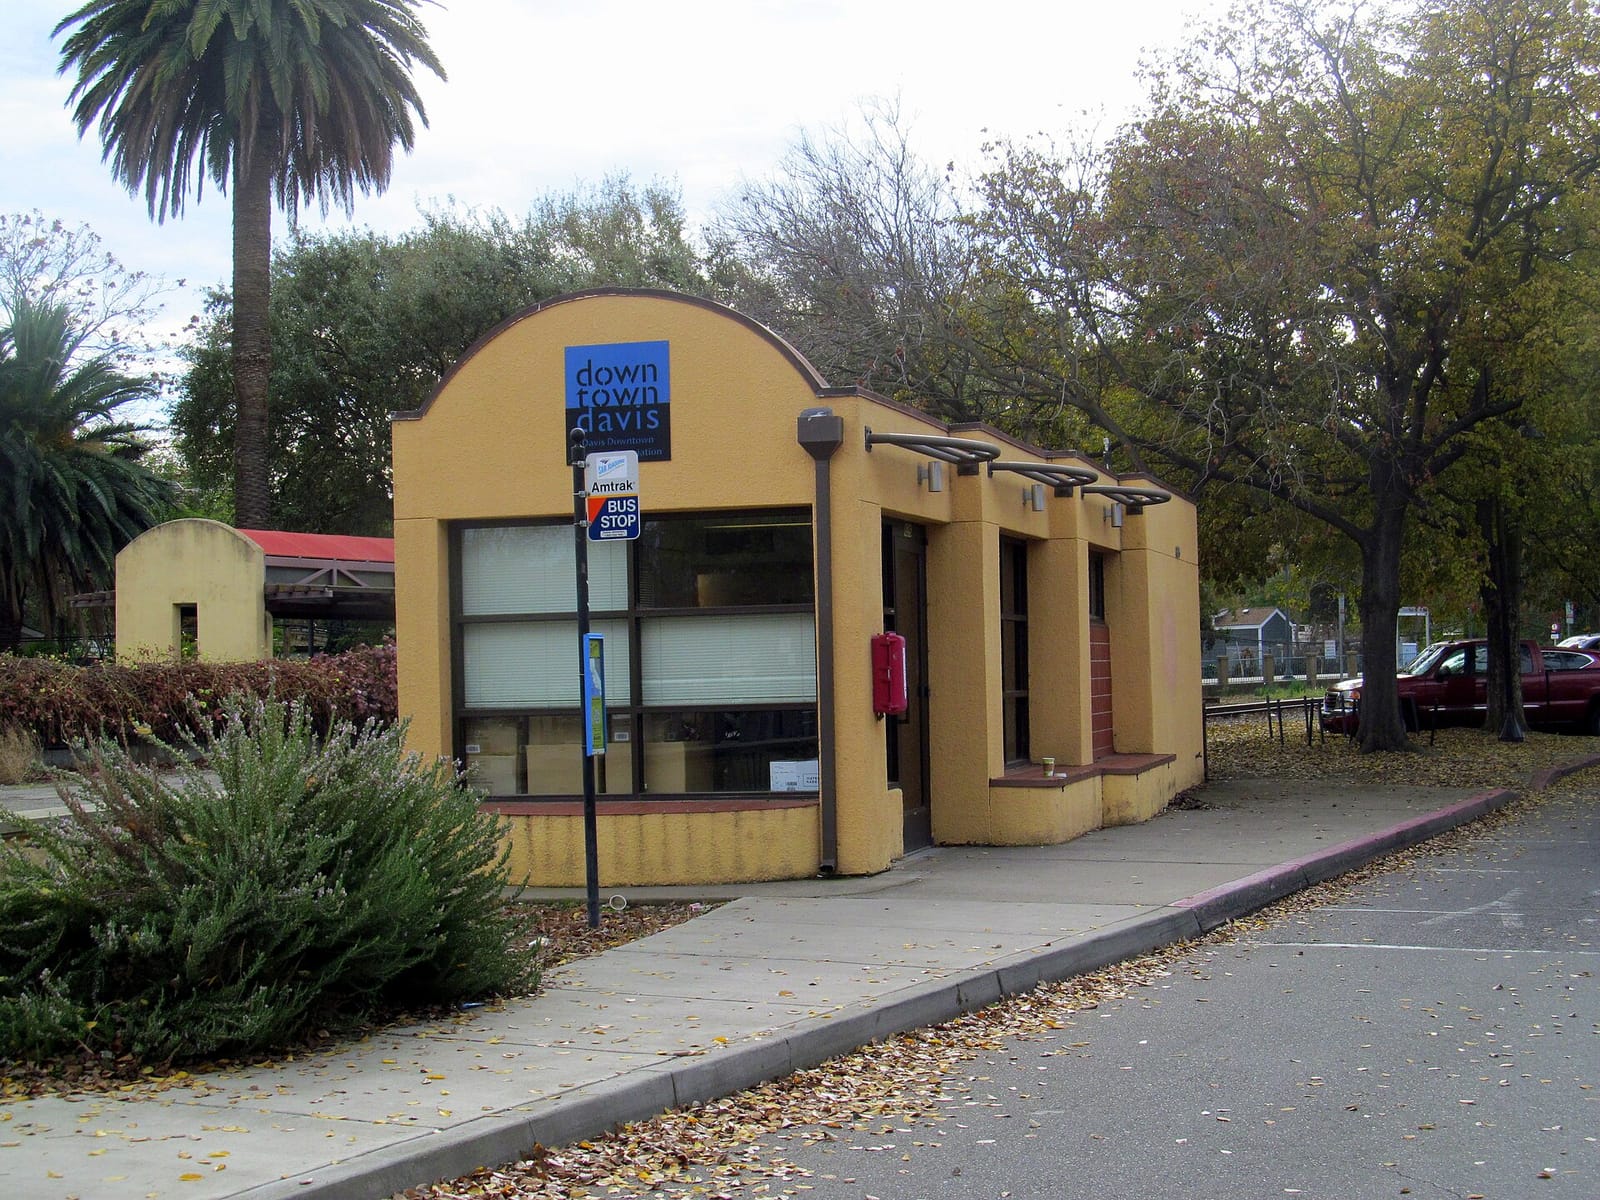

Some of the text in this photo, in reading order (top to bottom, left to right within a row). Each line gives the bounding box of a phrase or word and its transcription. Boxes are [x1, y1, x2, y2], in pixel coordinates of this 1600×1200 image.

[576, 359, 658, 386] down
[576, 387, 658, 407] town
[576, 405, 660, 433] davis
[592, 480, 633, 493] Amtrak
[607, 499, 636, 513] BUS
[600, 514, 636, 528] STOP
